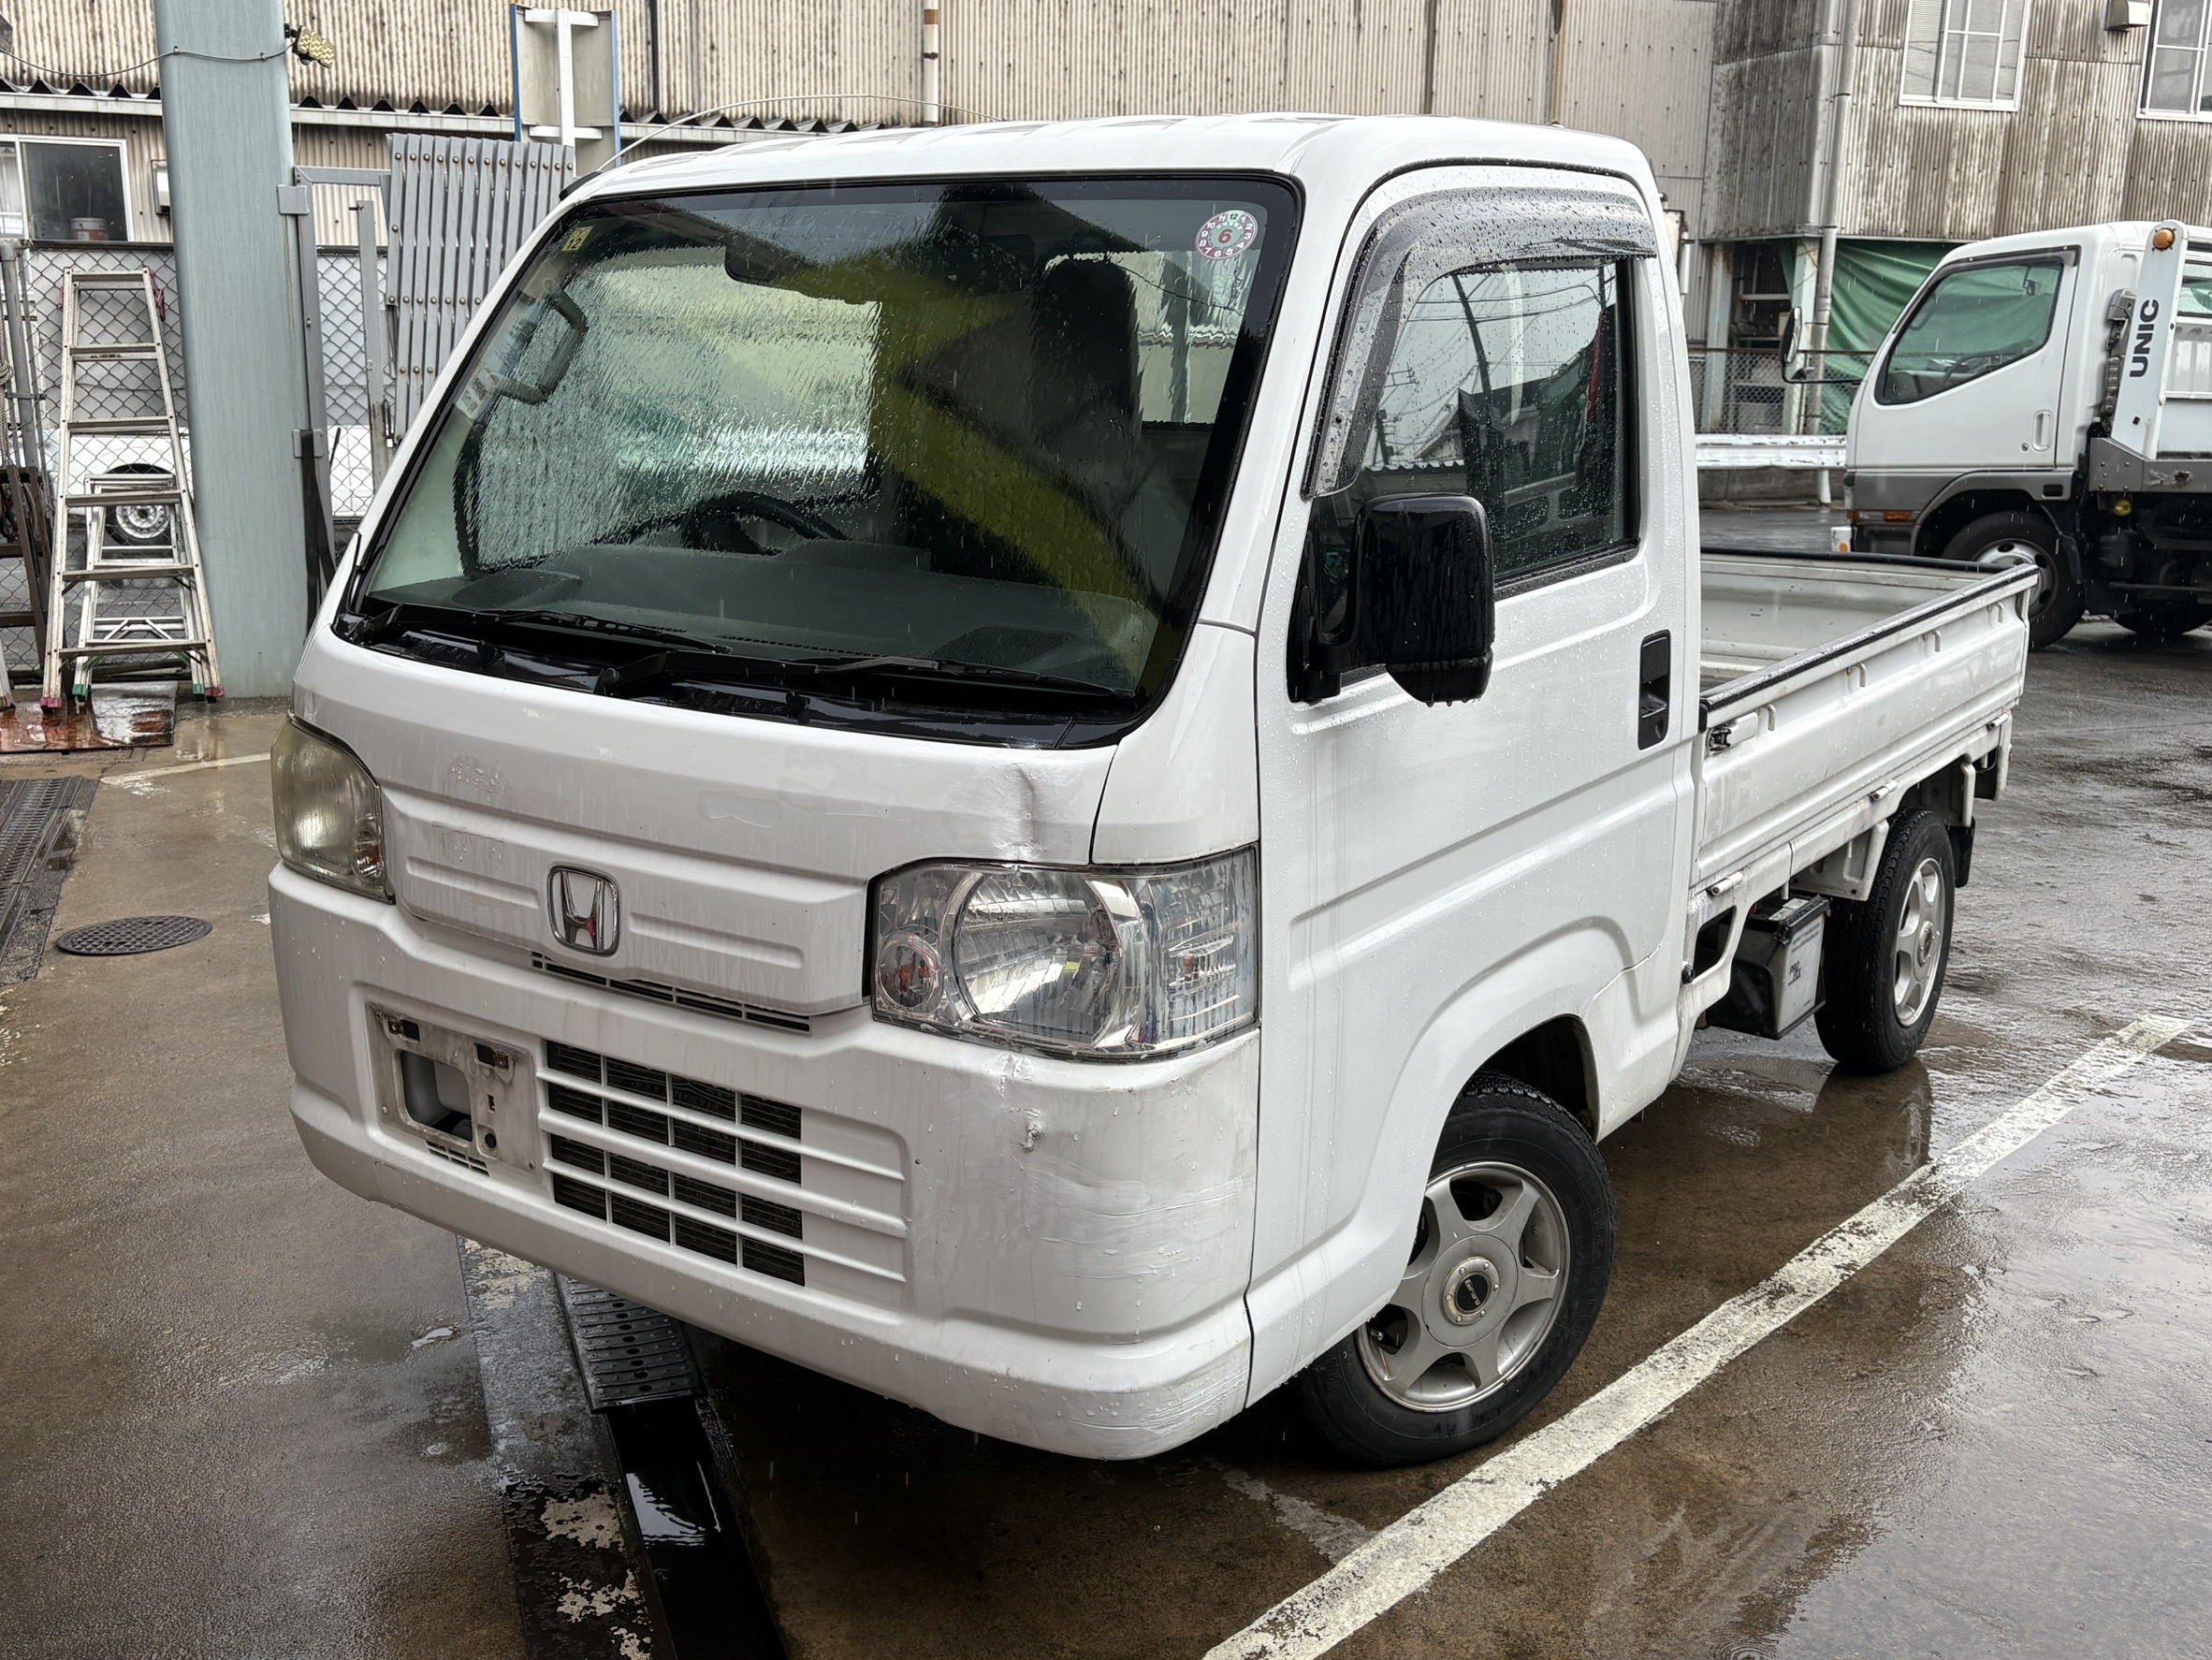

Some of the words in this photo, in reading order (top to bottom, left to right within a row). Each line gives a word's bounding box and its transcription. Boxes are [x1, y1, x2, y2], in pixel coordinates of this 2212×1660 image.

[566, 238, 581, 250] 12
[1218, 228, 1232, 244] 6
[2129, 299, 2160, 377] UNIC
